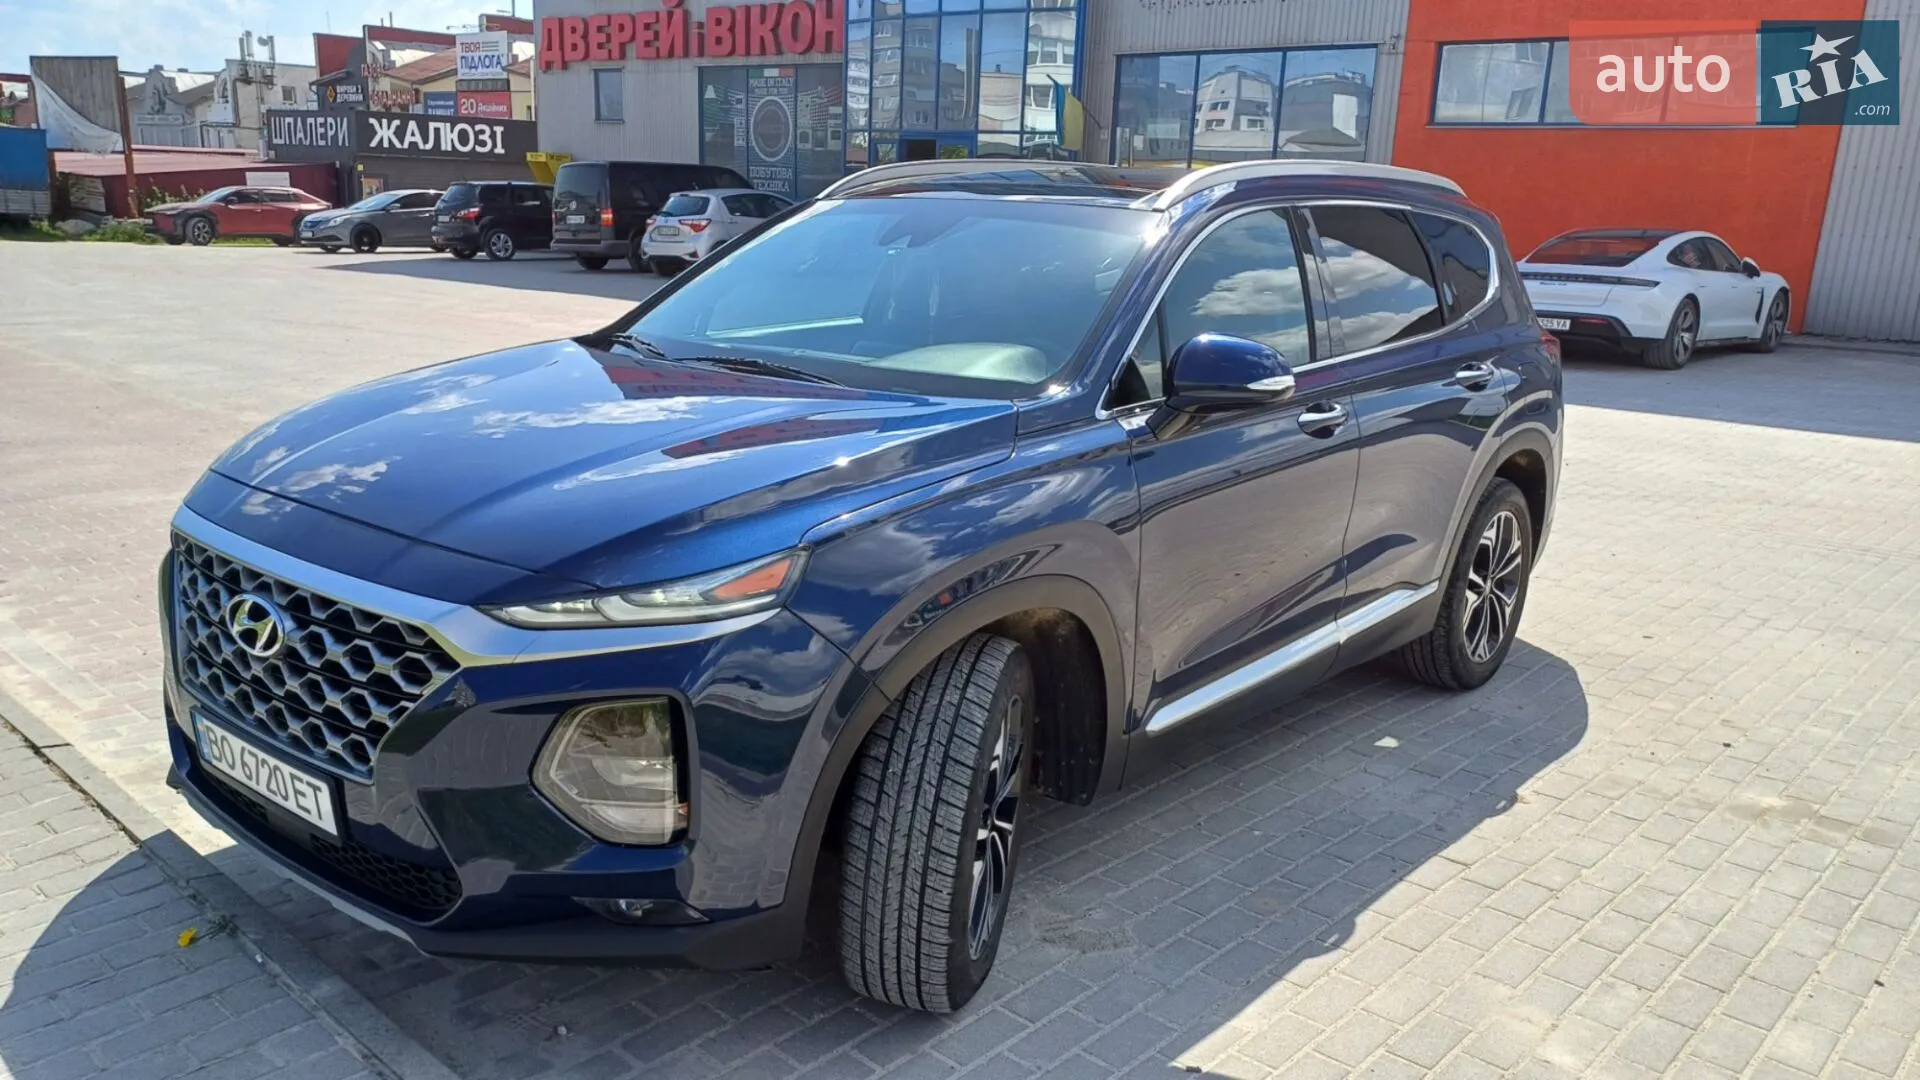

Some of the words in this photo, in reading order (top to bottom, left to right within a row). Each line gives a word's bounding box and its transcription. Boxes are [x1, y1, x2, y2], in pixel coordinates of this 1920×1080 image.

[540, 0, 687, 71] ДВЕРЕЙ
[706, 0, 843, 57] ВІКОН
[460, 42, 481, 53] ТВОЯ
[460, 54, 503, 71] ПІДЛОГА
[460, 98, 476, 114] 20
[271, 117, 349, 147] ШПАЛЕРИ
[368, 117, 505, 154] ЖАЛЮЗІ
[749, 167, 793, 179] ПОБУТОВА
[752, 180, 790, 192] ТЕХНІКА
[205, 725, 235, 771] BO
[240, 746, 289, 802] 6720
[289, 772, 323, 821] ET
